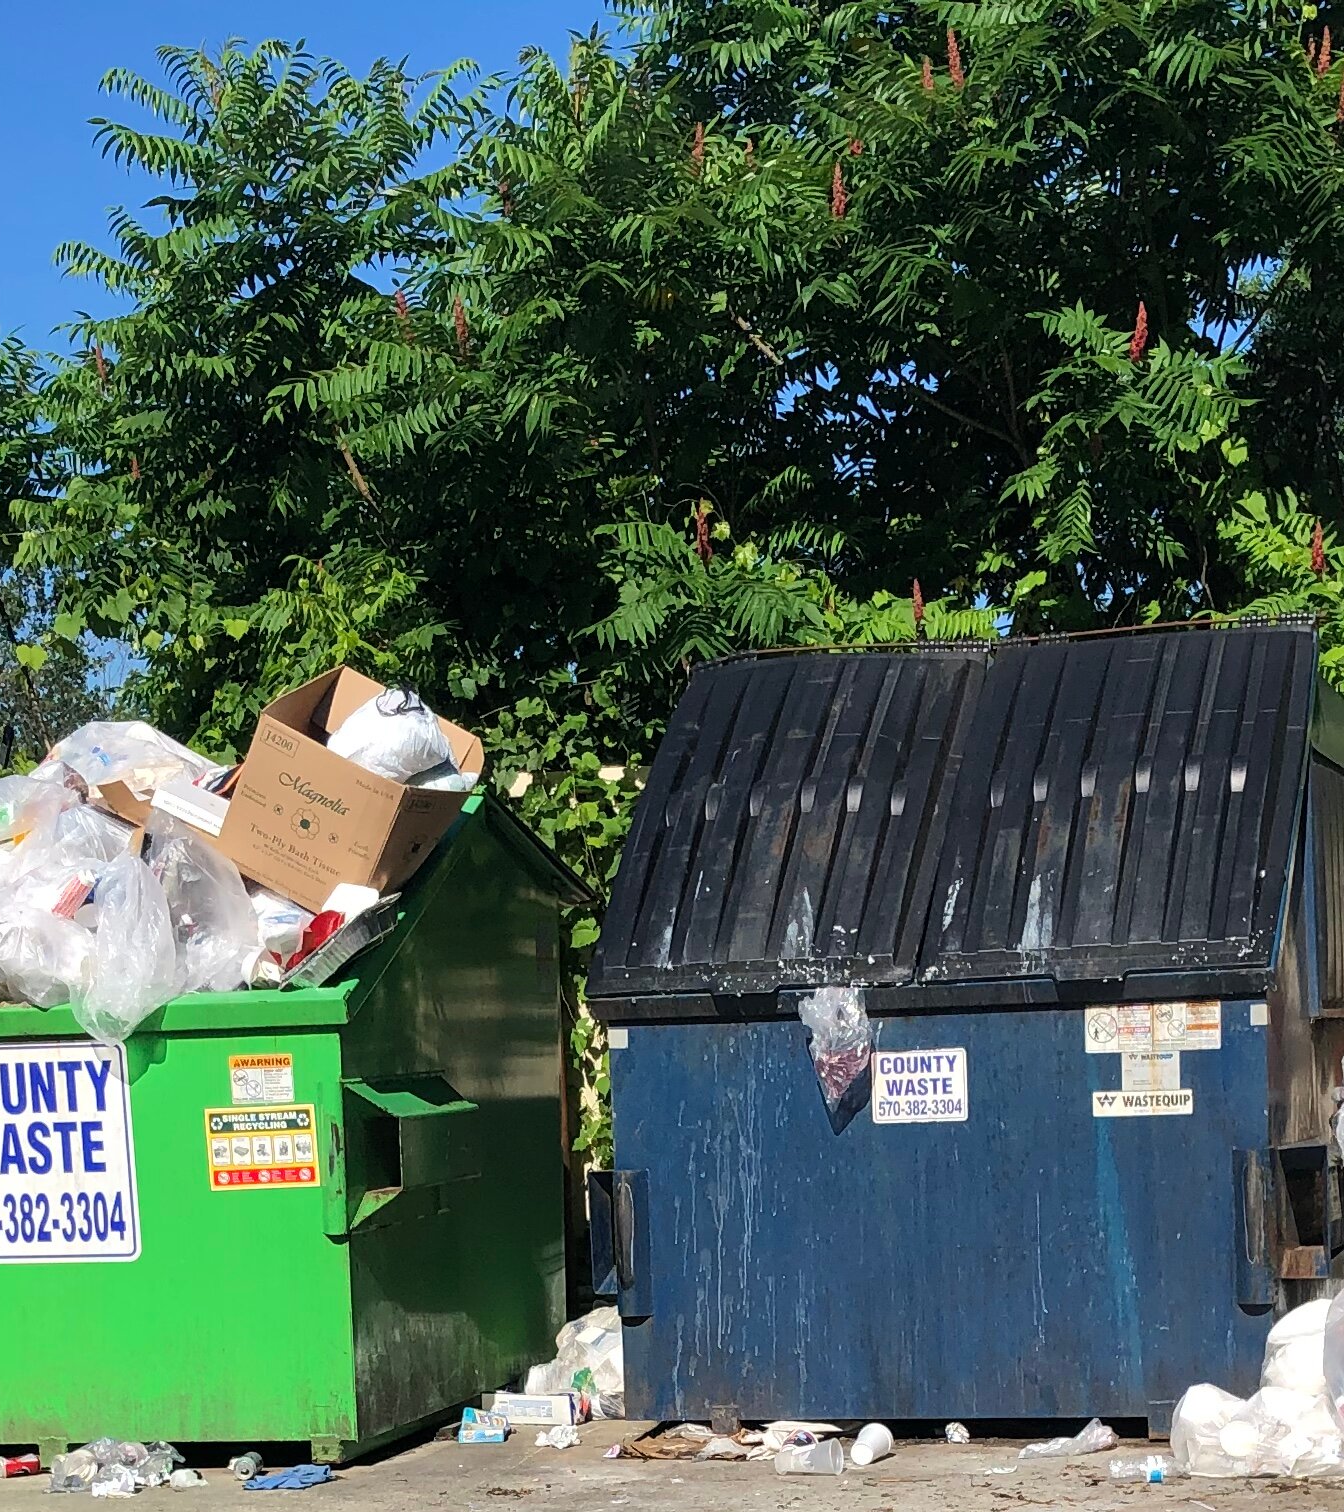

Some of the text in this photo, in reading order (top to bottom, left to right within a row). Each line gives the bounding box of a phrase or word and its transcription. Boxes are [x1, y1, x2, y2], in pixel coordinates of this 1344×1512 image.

[264, 730, 293, 752] J4200
[278, 771, 351, 817] Magnolia
[250, 822, 286, 850] Two-Ply
[288, 846, 310, 862] Bath
[313, 853, 341, 877] Tissue
[240, 1057, 291, 1068] WARNING
[880, 1055, 957, 1075] COUNTY
[885, 1077, 953, 1096] WASTE
[878, 1098, 962, 1117] 570-382-3304
[1122, 1094, 1191, 1107] WASTEQUIP
[222, 1111, 297, 1123] SINGLE STREAM
[233, 1121, 288, 1131] RECYCLING
